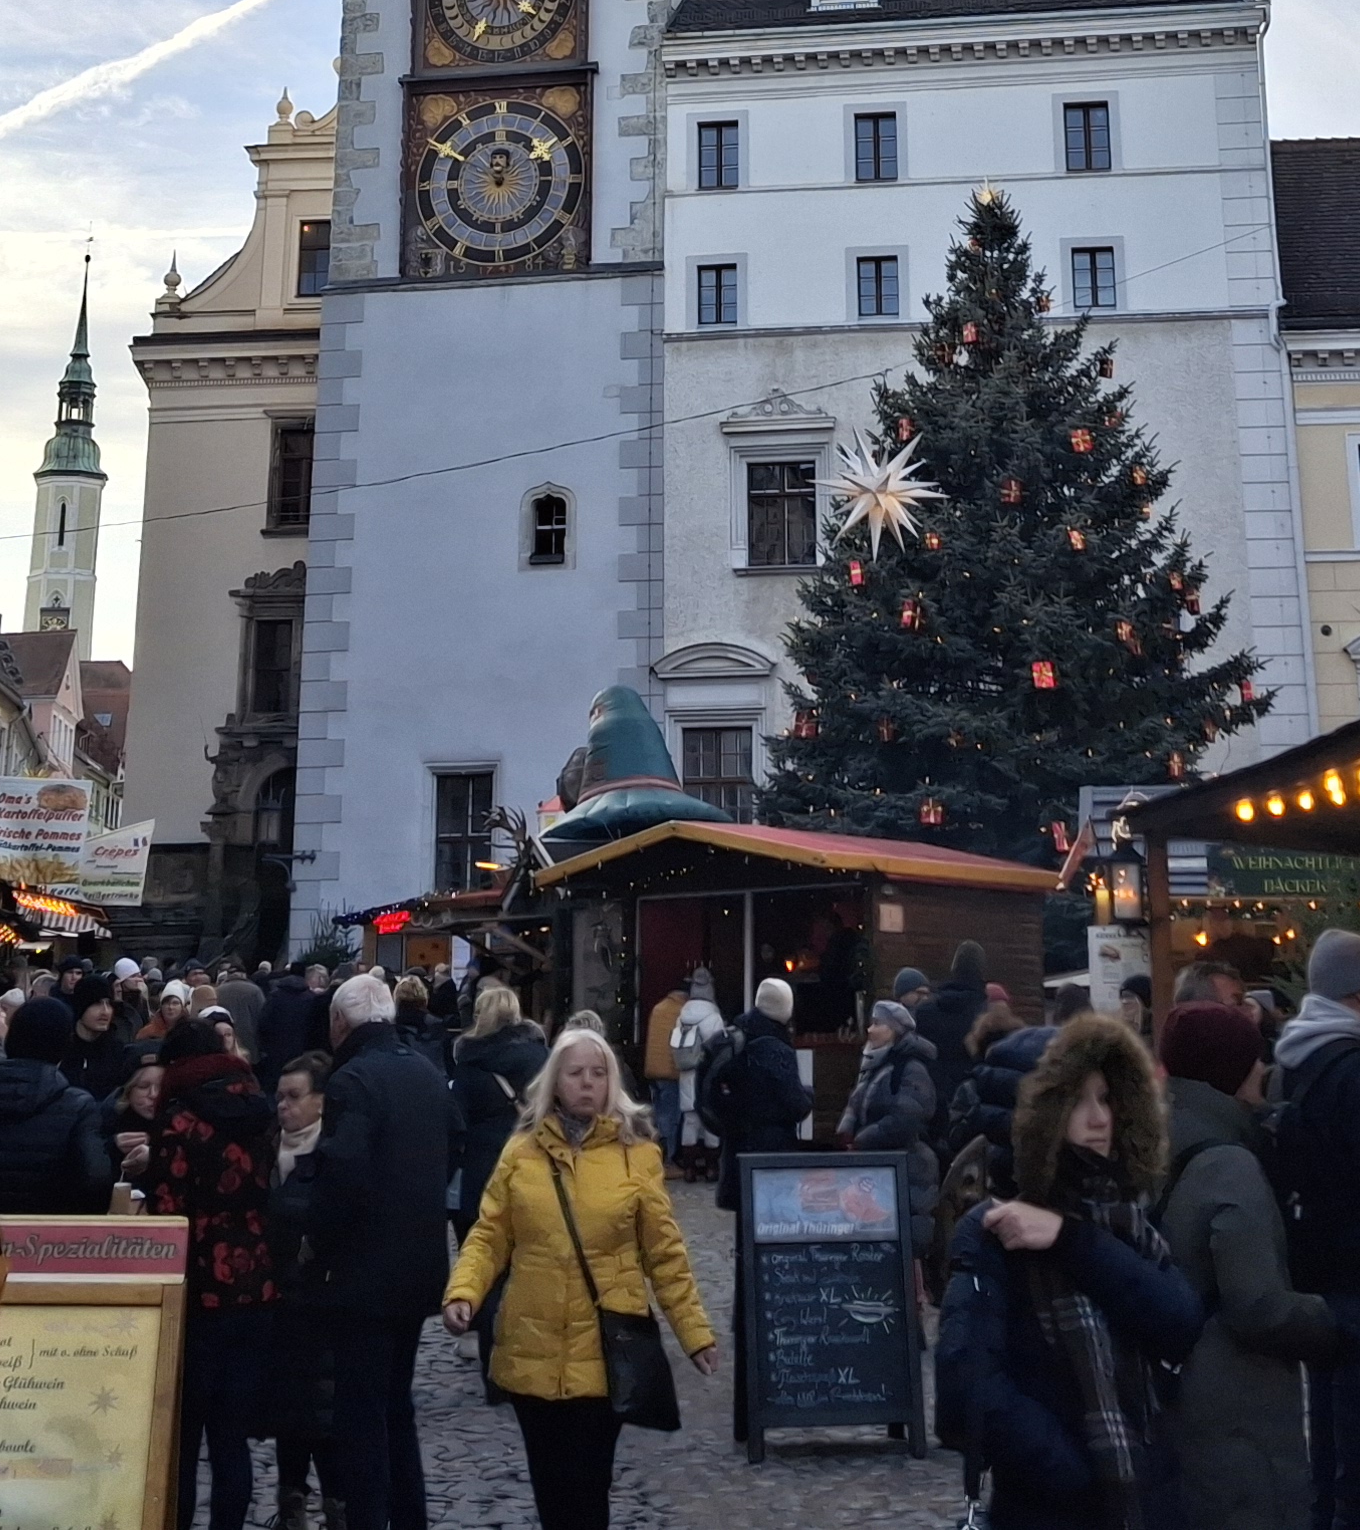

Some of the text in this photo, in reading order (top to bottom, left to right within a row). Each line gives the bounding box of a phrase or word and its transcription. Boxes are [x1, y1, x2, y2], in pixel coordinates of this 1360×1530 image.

[494, 51, 505, 61] 12
[494, 101, 508, 113] XII
[449, 260, 466, 273] 15
[525, 255, 545, 271] 84
[35, 828, 82, 841] Pommes
[1, 1234, 176, 1265] n-Spezialitäten
[820, 1287, 841, 1304] XL
[39, 1347, 58, 1358] mit
[73, 1346, 99, 1358] ohne
[102, 1344, 138, 1360] Schuß
[838, 1367, 860, 1384] XL
